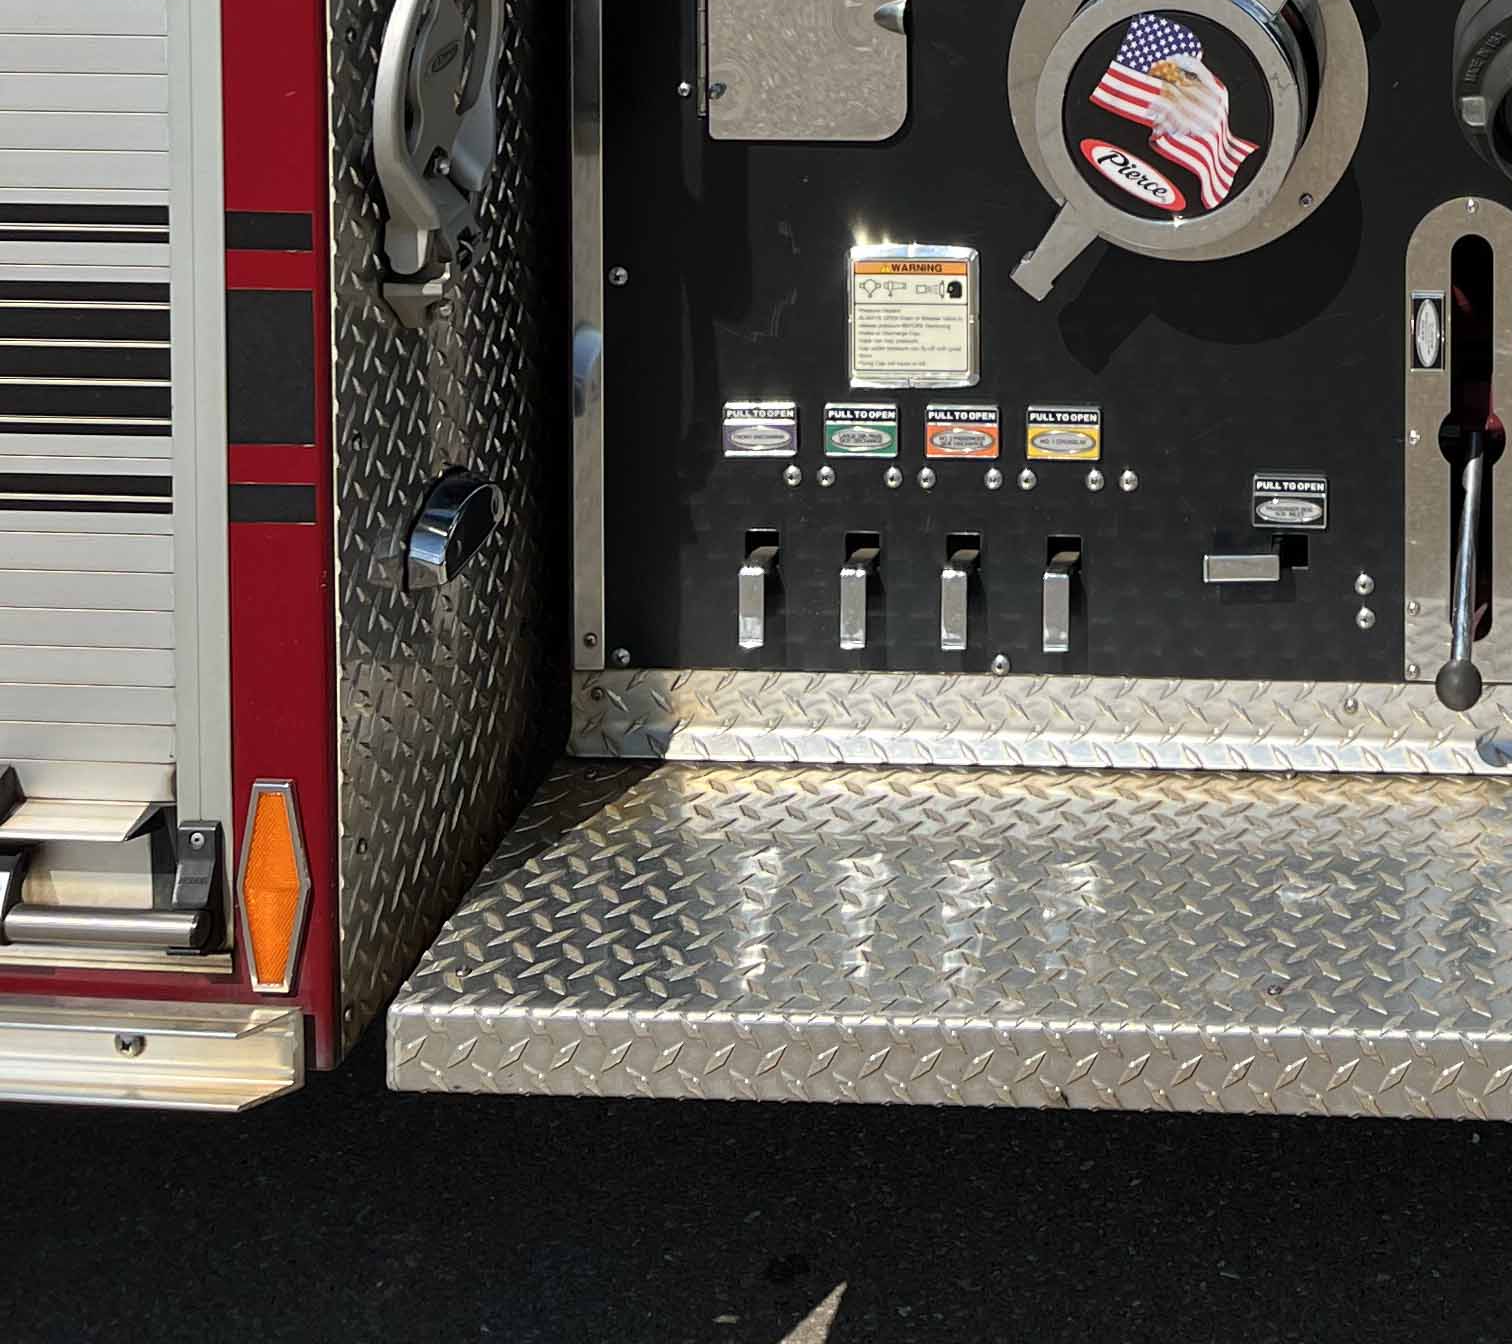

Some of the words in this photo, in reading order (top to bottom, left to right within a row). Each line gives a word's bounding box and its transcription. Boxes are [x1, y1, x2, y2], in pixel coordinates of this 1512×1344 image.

[1097, 150, 1168, 199] Pierce
[891, 263, 943, 273] WARNING
[726, 409, 751, 418] PULL
[752, 409, 765, 418] TO
[765, 409, 794, 418] OPEN
[828, 409, 854, 419] PULL
[854, 409, 868, 419] TO
[868, 410, 896, 419] OPEN
[928, 411, 954, 420] PULL
[954, 411, 968, 420] TO
[968, 411, 996, 421] OPEN
[1029, 412, 1055, 422] PULL
[1055, 413, 1069, 422] TO
[1070, 413, 1098, 423] OPEN
[1256, 480, 1281, 490] PULL
[1282, 481, 1296, 490] TO
[1297, 482, 1325, 491] OPEN
